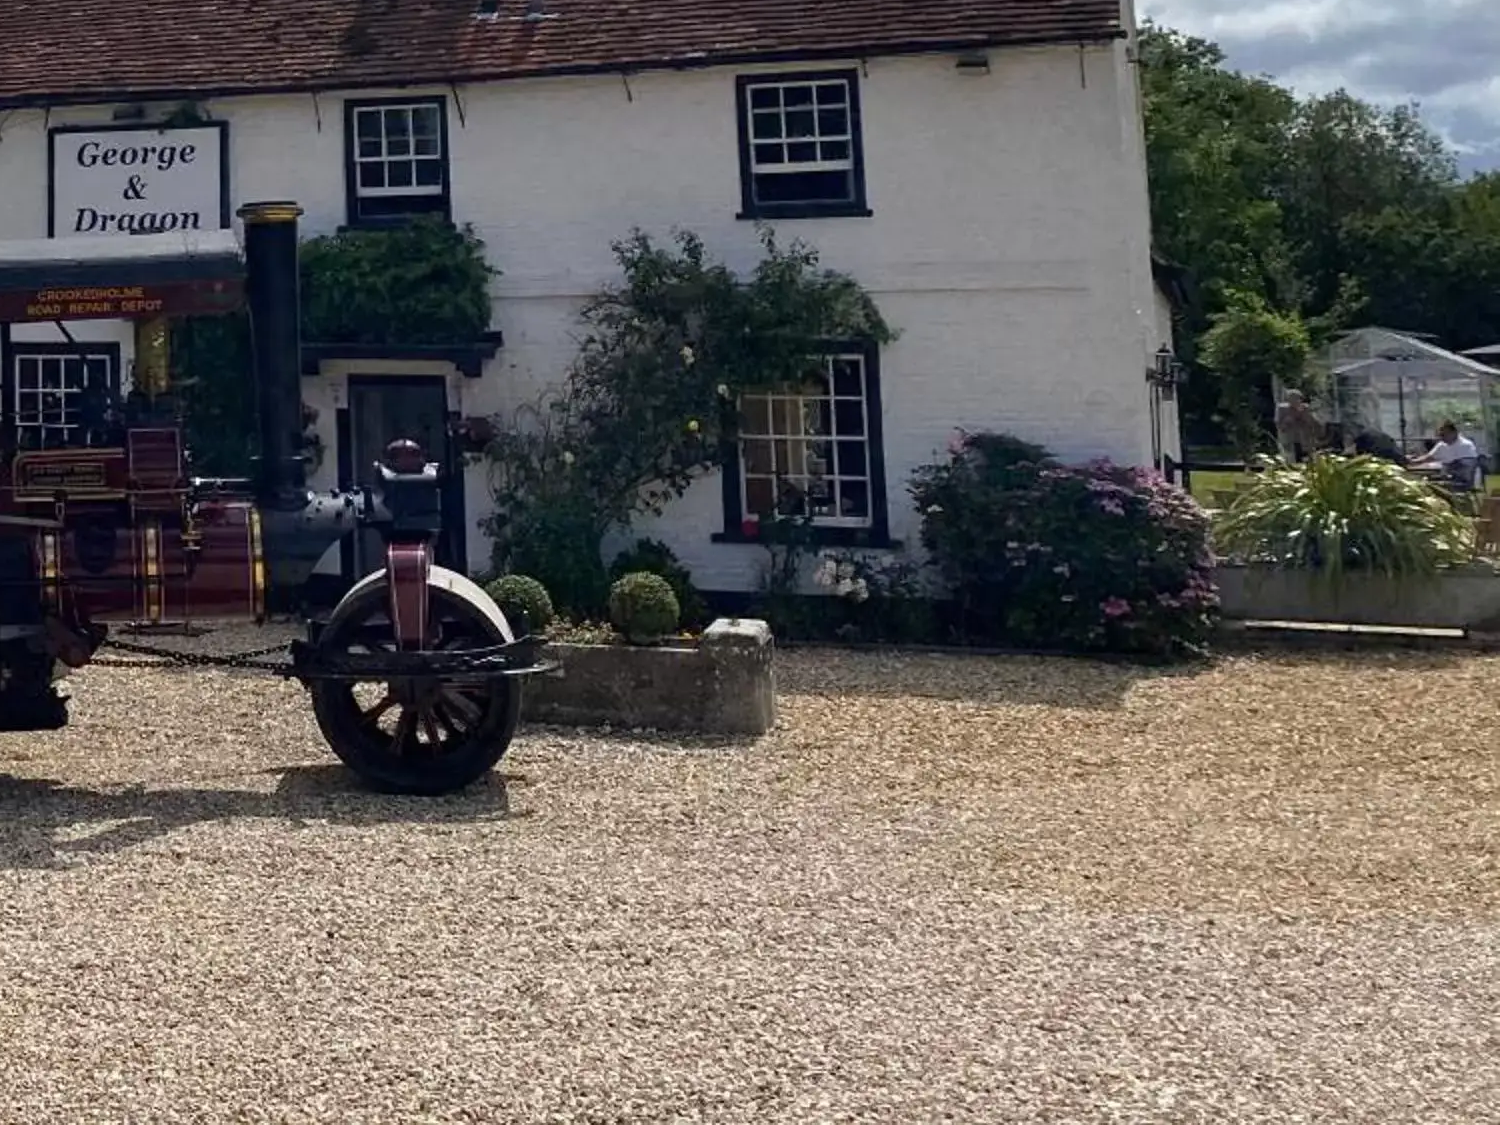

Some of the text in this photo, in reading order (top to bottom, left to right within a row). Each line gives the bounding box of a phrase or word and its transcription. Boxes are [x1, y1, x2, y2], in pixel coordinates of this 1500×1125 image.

[77, 142, 197, 171] George
[123, 174, 148, 200] &
[27, 303, 61, 316] ROAD
[121, 299, 162, 313] DEPOT
